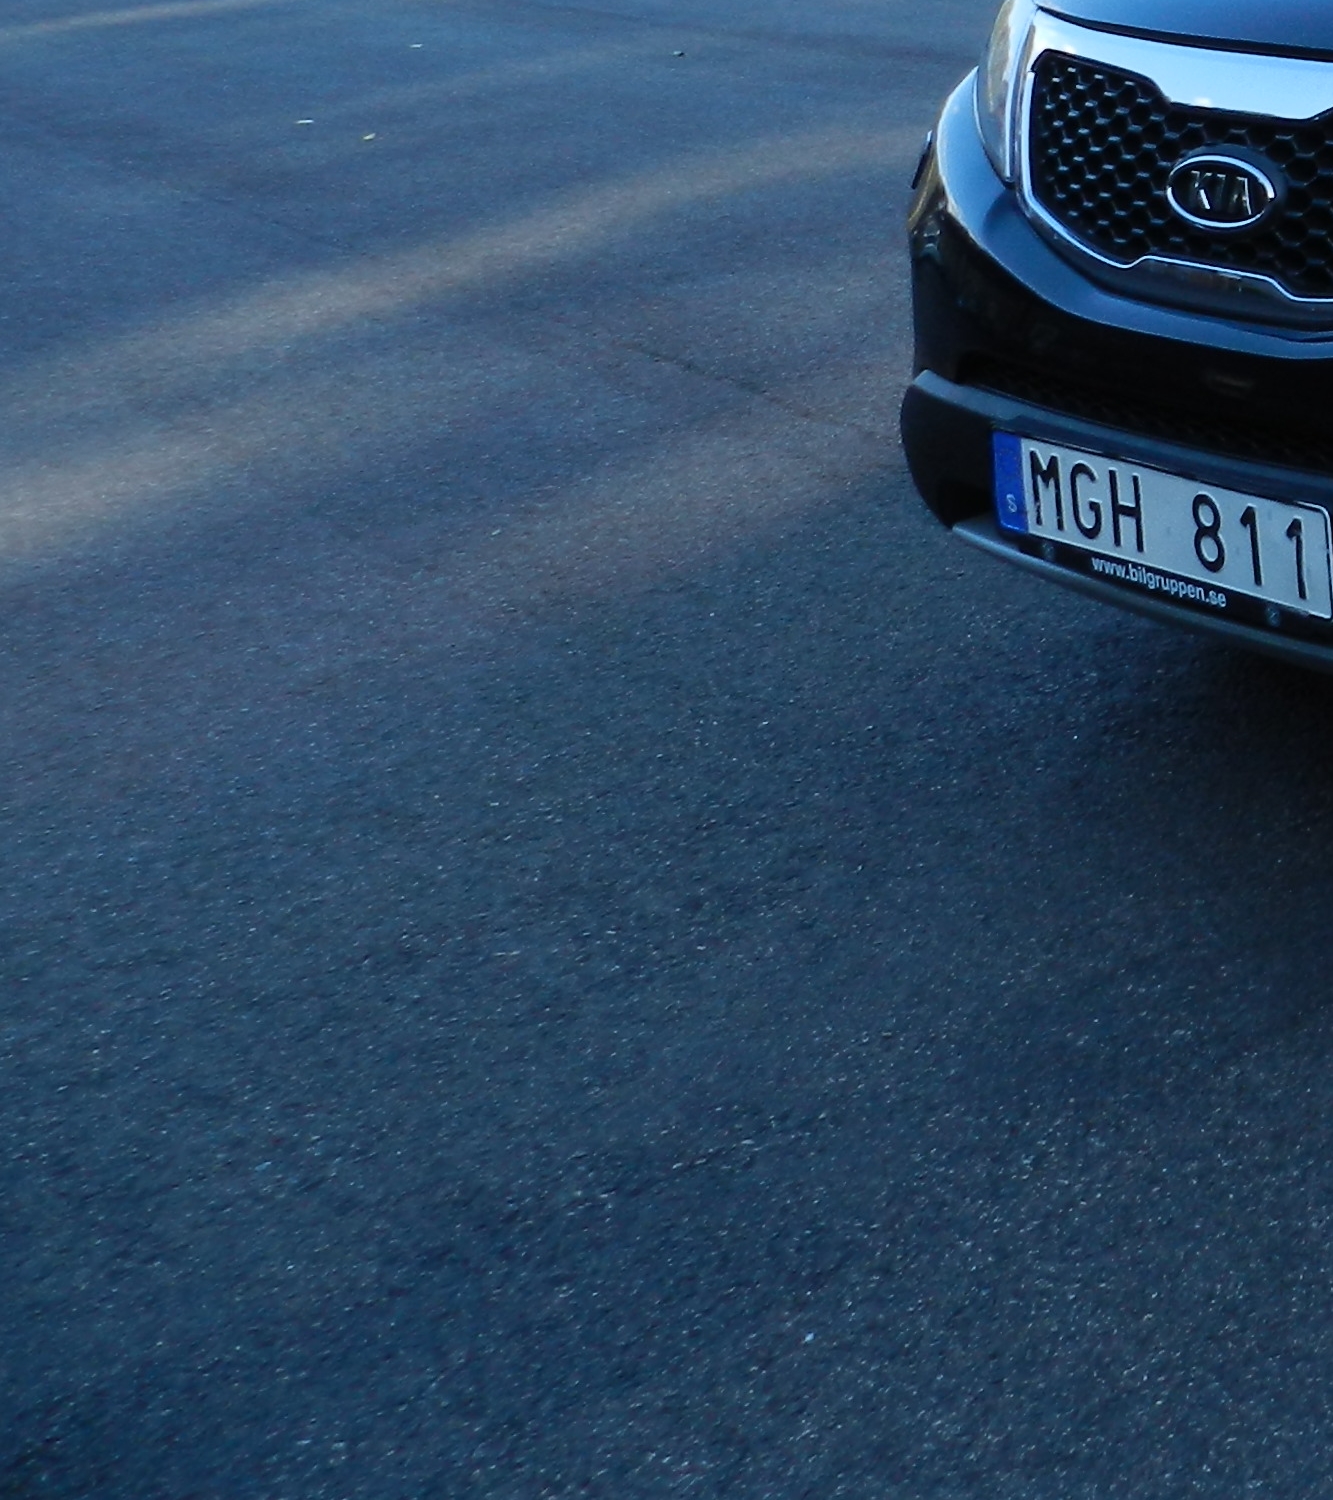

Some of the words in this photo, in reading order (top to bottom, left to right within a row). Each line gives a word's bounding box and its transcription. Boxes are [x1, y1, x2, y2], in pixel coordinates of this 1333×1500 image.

[1190, 169, 1252, 216] KIA
[1030, 449, 1144, 553] MGH
[1192, 492, 1307, 601] 811
[1091, 557, 1227, 608] www.bilgruppen.se
